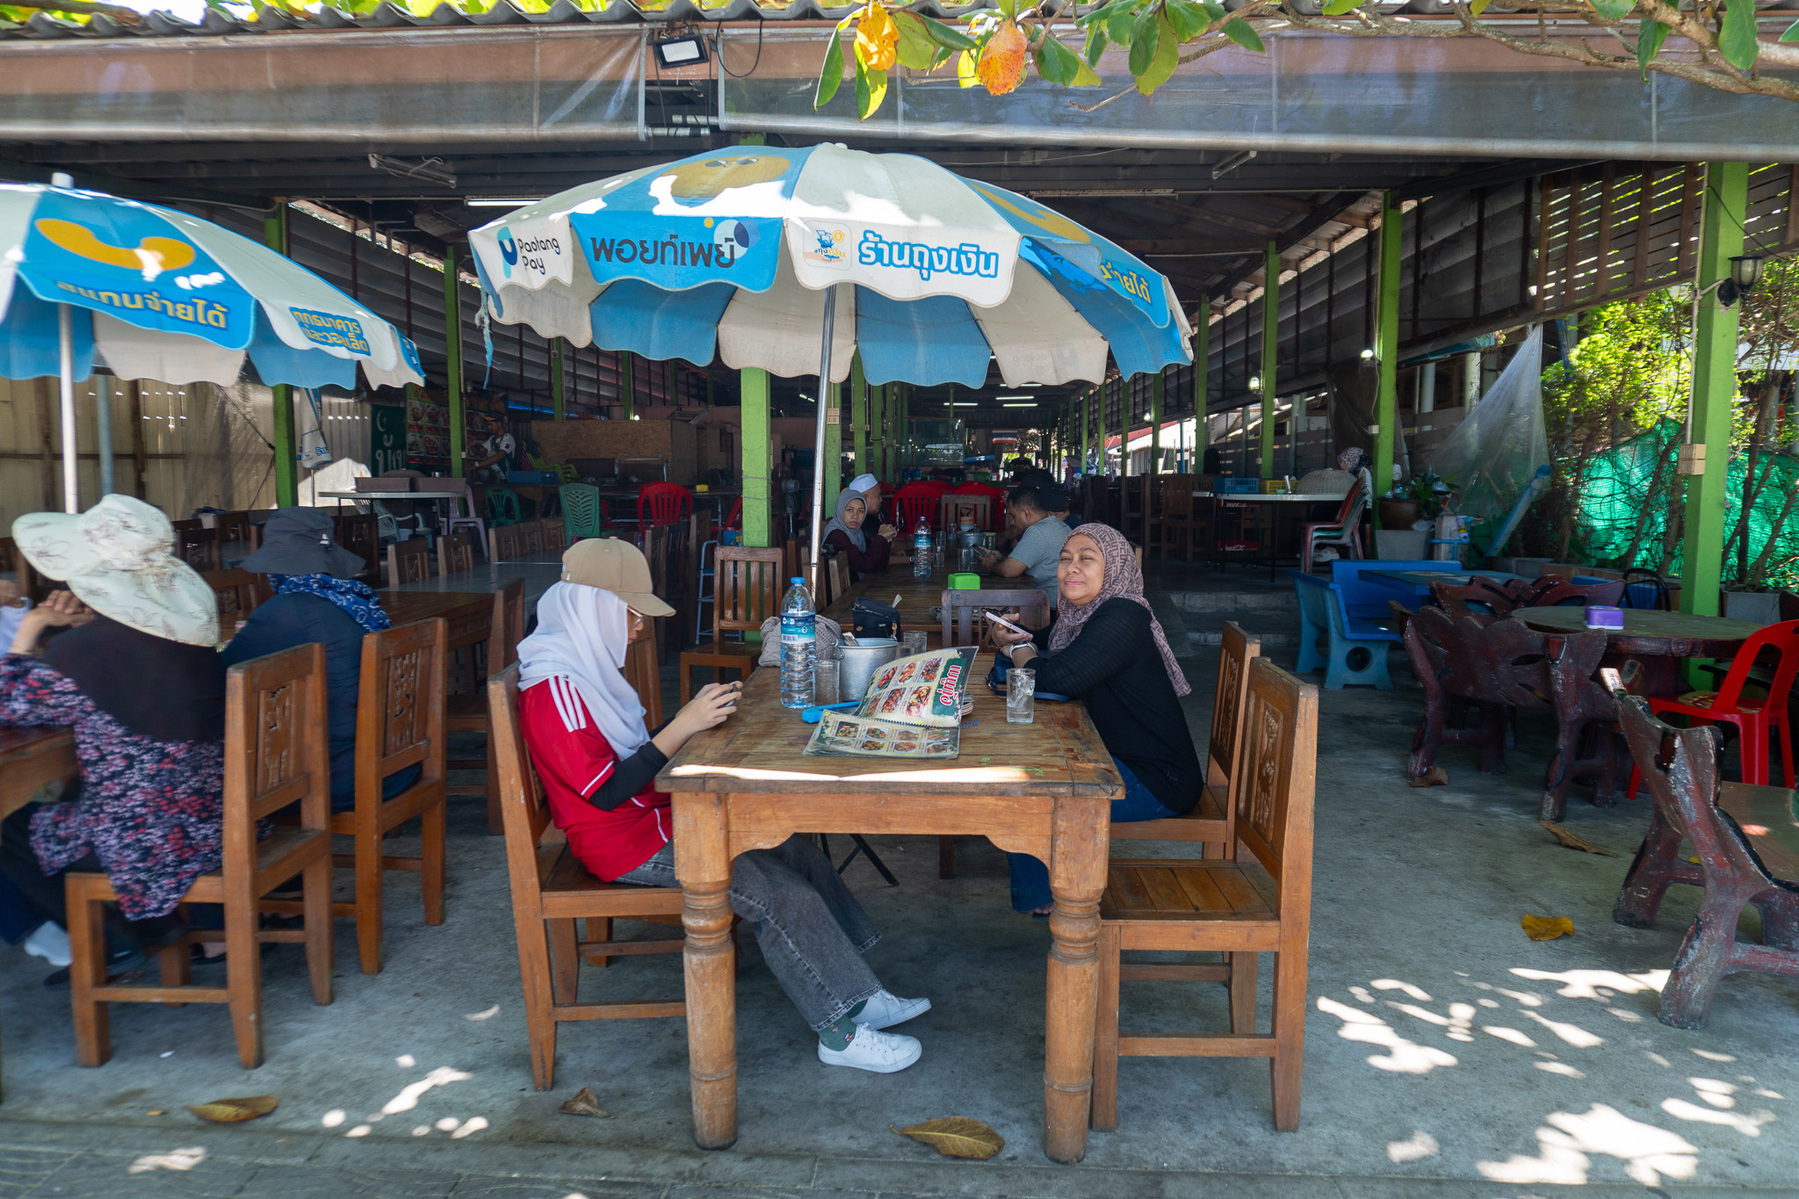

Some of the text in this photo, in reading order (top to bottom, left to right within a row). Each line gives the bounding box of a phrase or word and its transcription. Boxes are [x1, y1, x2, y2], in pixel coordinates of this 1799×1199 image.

[517, 236, 561, 255] Paotang
[590, 234, 735, 269] พอยท์เพย์
[858, 230, 999, 281] ร้านถุงเงิน
[521, 255, 546, 275] Pay
